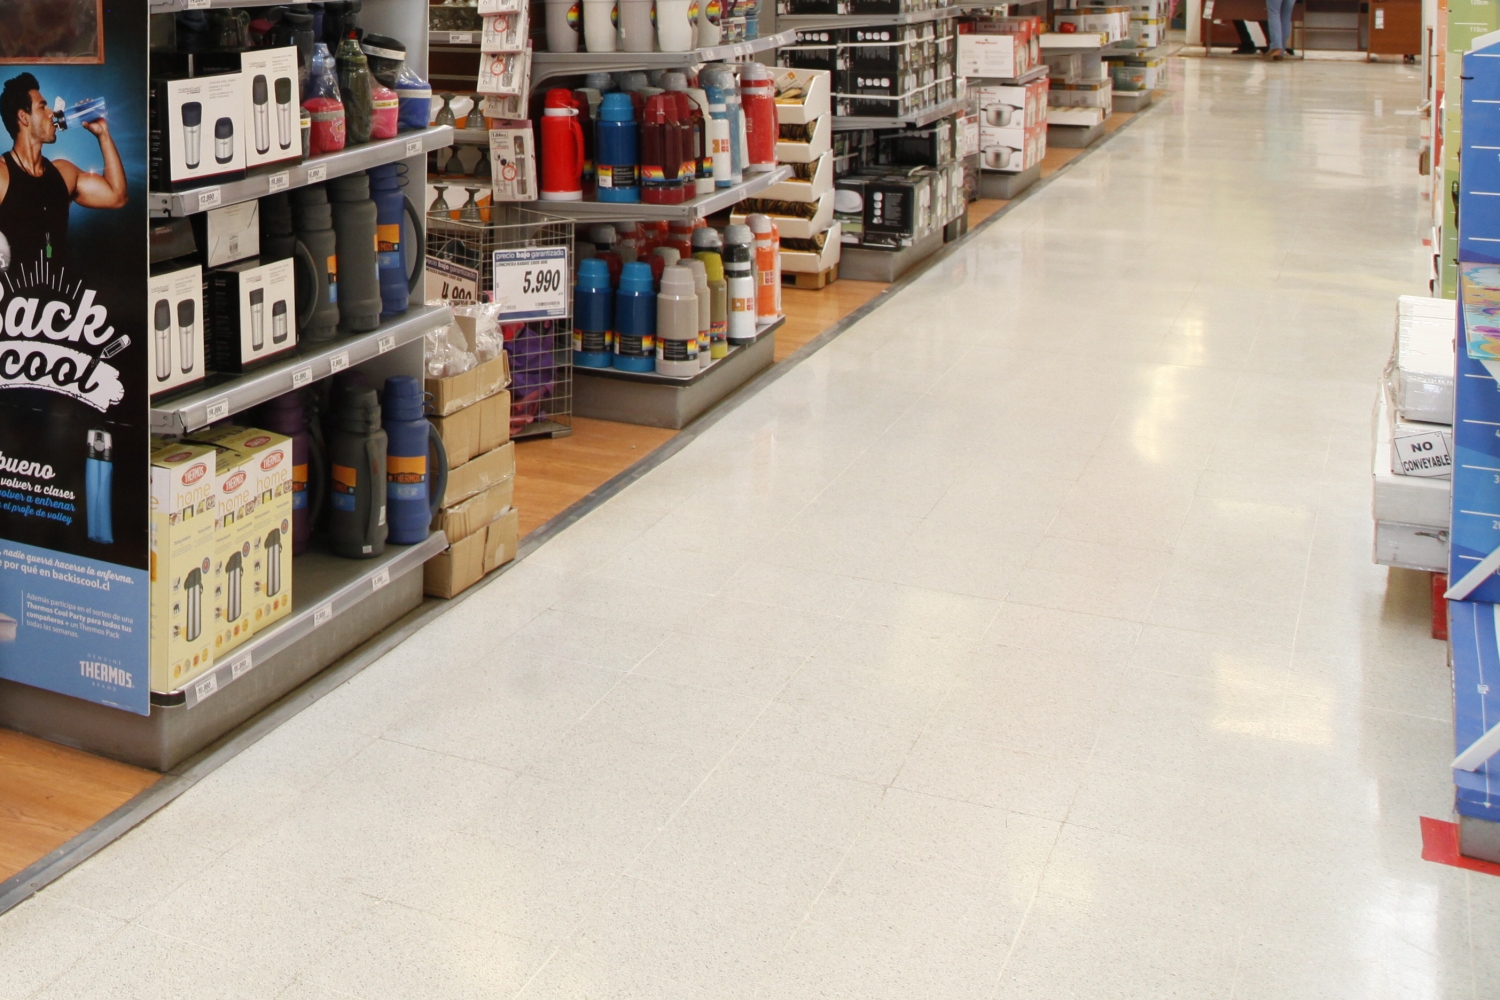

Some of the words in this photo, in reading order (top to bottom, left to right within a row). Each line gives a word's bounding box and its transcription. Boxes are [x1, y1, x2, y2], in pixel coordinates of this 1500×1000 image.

[496, 251, 515, 260] precio
[516, 251, 530, 259] bajo
[531, 250, 564, 259] garantizado
[523, 269, 561, 294] 5.990
[1411, 441, 1433, 453] NO
[261, 452, 284, 470] THERMOS
[1403, 454, 1451, 472] CONVEYABLE
[184, 464, 207, 484] THERMOS
[223, 473, 246, 491] THERMOS
[256, 467, 288, 492] home
[393, 474, 421, 483] THERMOS
[0, 476, 33, 492] volver
[34, 484, 42, 493] a
[43, 485, 76, 500] clases
[177, 482, 211, 510] home
[34, 494, 76, 512] entrenar
[218, 488, 250, 515] home
[11, 503, 35, 516] profe
[35, 507, 46, 518] de
[47, 509, 73, 525] volley
[3, 545, 25, 560] nadie
[26, 551, 53, 568] querrá
[54, 557, 85, 574] hacerse
[96, 567, 135, 585] enferma.
[4, 557, 20, 573] por
[21, 561, 38, 578] qué
[39, 567, 51, 578] en
[52, 568, 111, 591] backiscool.cl
[26, 593, 49, 605] Además
[50, 599, 77, 611] participa
[92, 609, 112, 618] sorteo
[26, 601, 53, 614] Thermos
[54, 608, 68, 617] Cool
[69, 611, 86, 623] Party
[86, 616, 101, 626] para
[102, 620, 121, 630] todos
[121, 624, 132, 633] tus
[26, 619, 43, 629] todas
[26, 611, 64, 626] compañeros
[79, 622, 105, 635] Thermos
[105, 629, 120, 639] Pack
[79, 660, 133, 688] THERMOS
